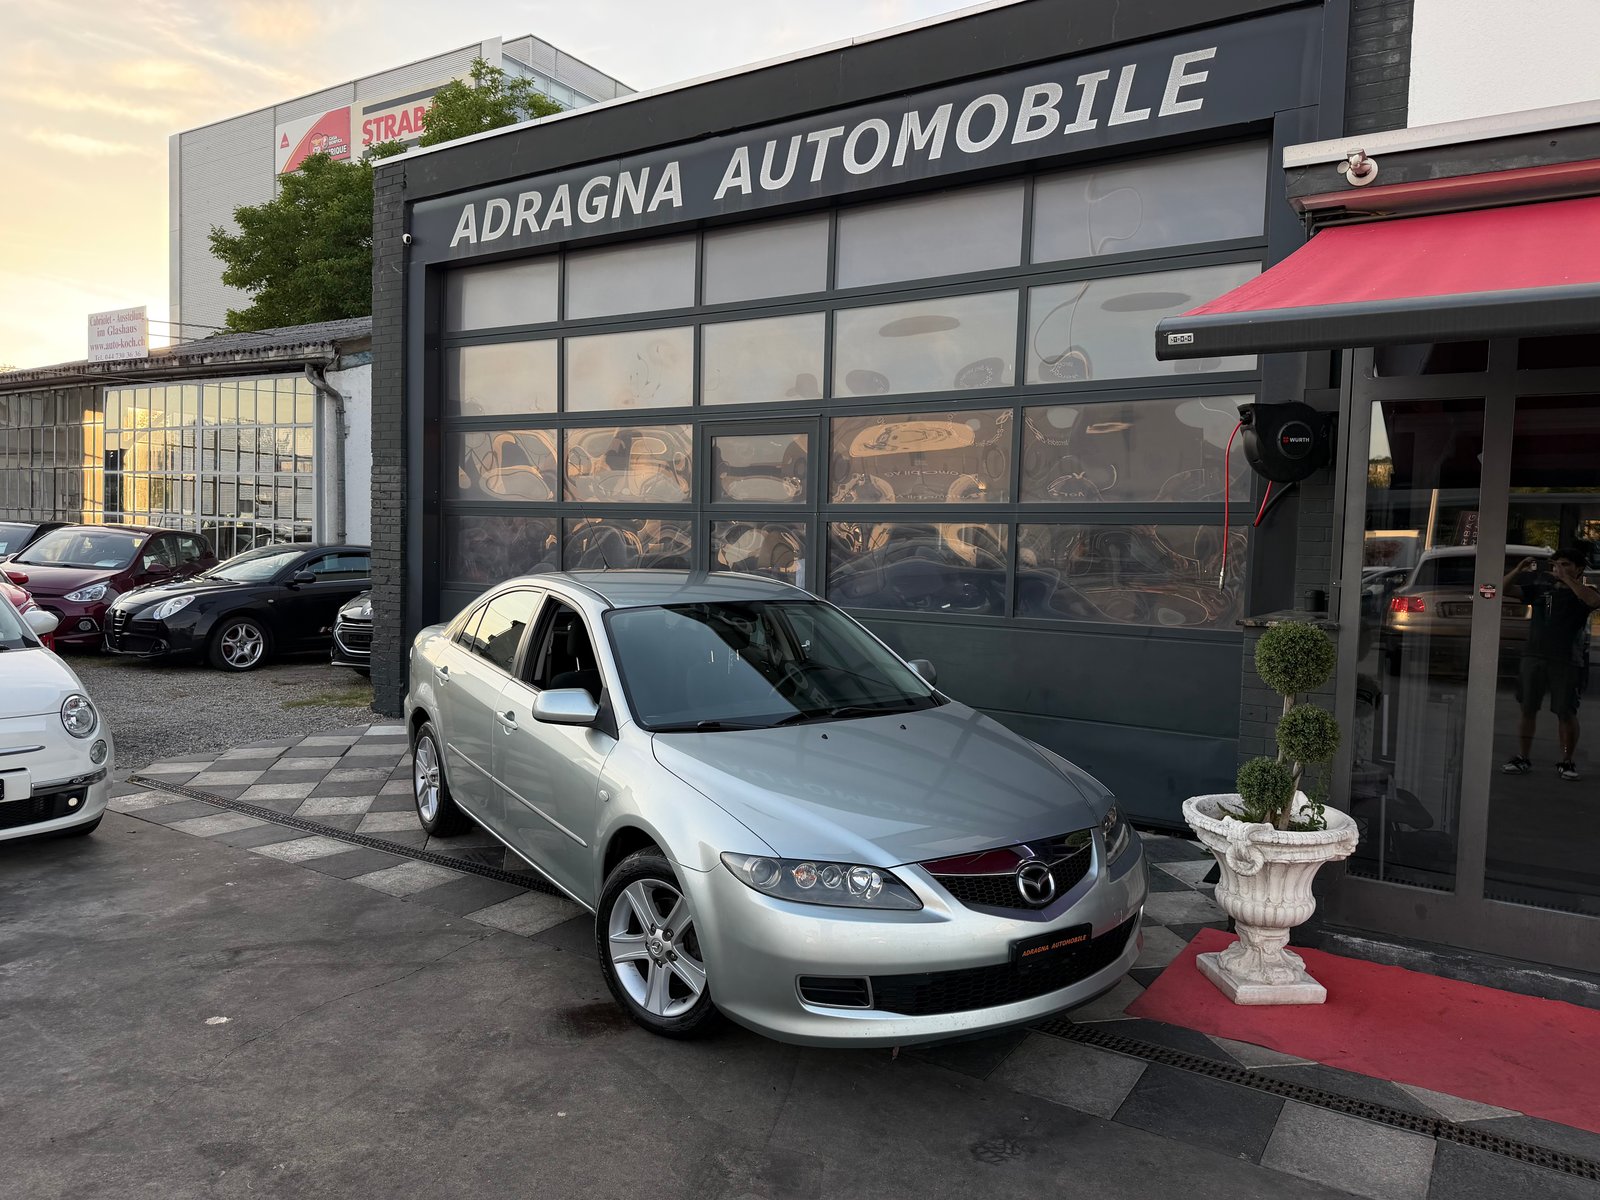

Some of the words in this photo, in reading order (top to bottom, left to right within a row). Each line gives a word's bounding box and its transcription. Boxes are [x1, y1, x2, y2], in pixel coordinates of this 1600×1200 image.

[362, 106, 427, 145] STRAB
[326, 144, 347, 156] RIQUE
[449, 160, 684, 248] ADRAGNA
[713, 46, 1217, 201] AUTOMOBILE
[97, 328, 105, 338] im
[107, 324, 137, 336] Glashaus
[89, 336, 146, 351] www.auto-koch.ch
[1022, 945, 1049, 957] ADRAGNA
[1051, 934, 1087, 949] AUTOMOBILE
